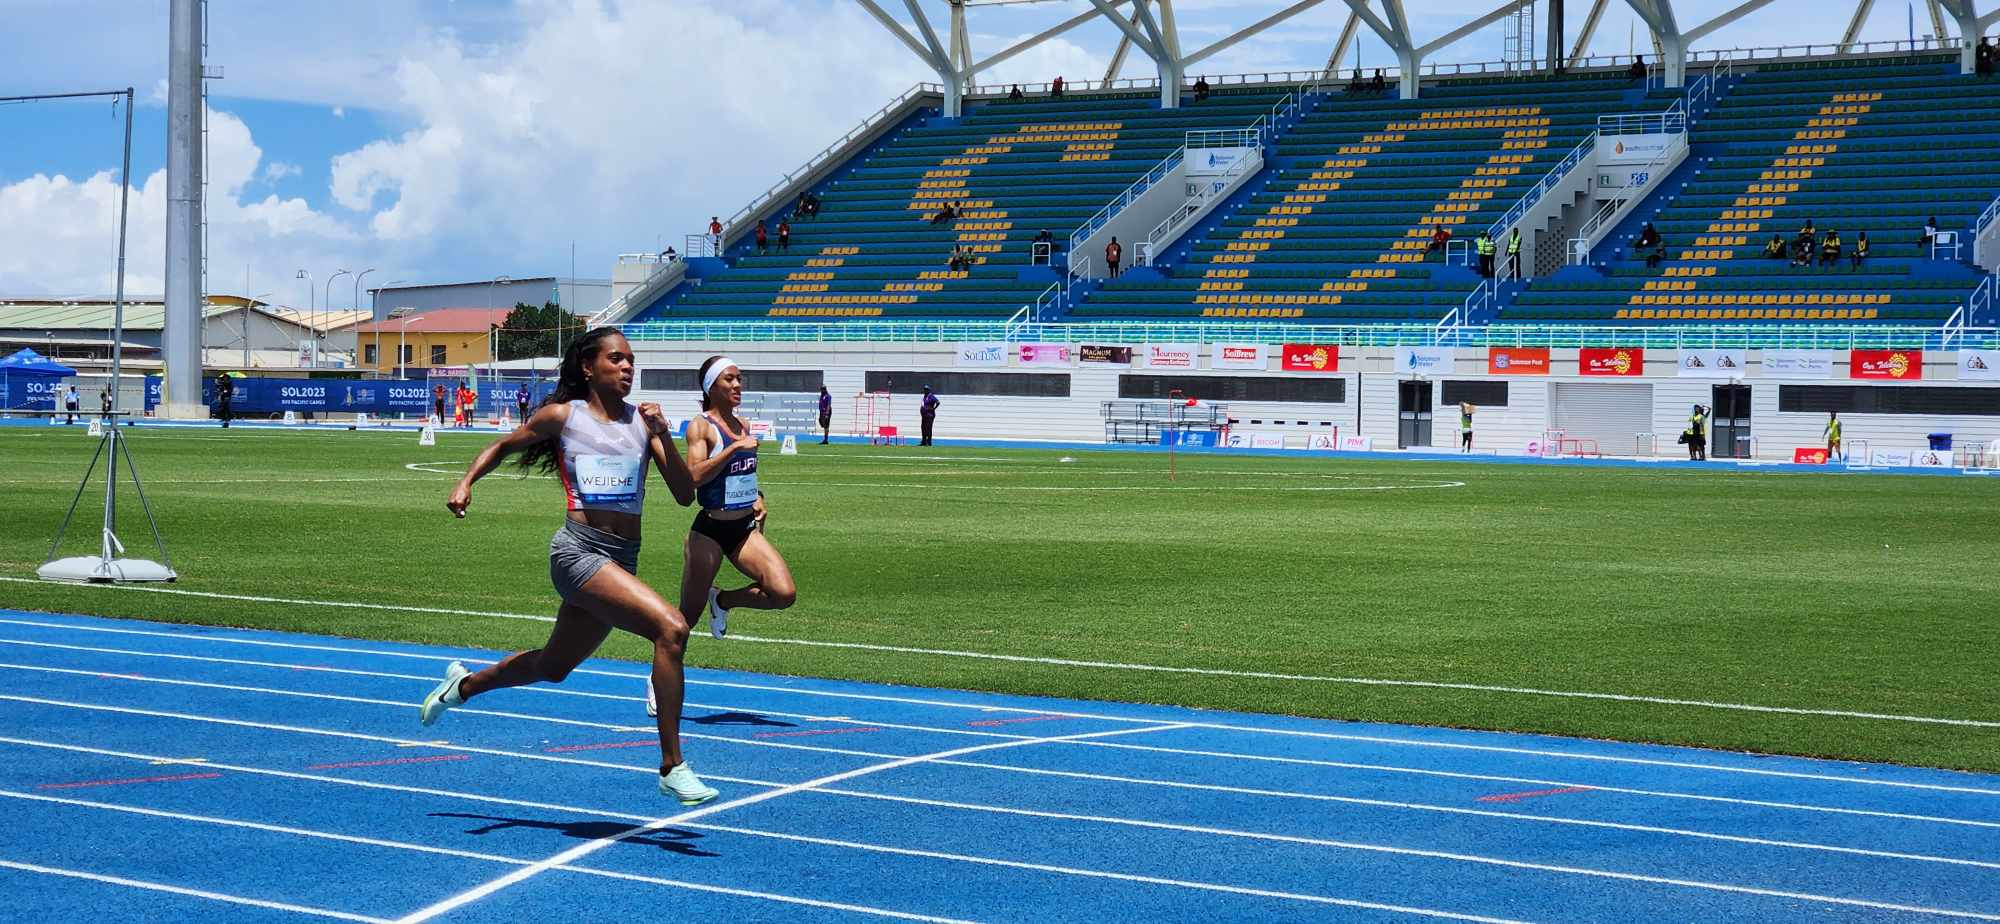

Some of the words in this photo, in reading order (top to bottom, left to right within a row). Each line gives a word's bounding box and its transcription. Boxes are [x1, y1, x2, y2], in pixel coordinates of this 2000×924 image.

[1082, 348, 1112, 357] MAGNUM
[1225, 349, 1256, 358] SolBrew
[1862, 362, 1875, 370] Our
[281, 387, 326, 398] SOL2023
[388, 388, 431, 398] SOL2023
[785, 439, 793, 449] 40
[730, 457, 758, 473] GUA
[581, 476, 633, 487] WEJIEME
